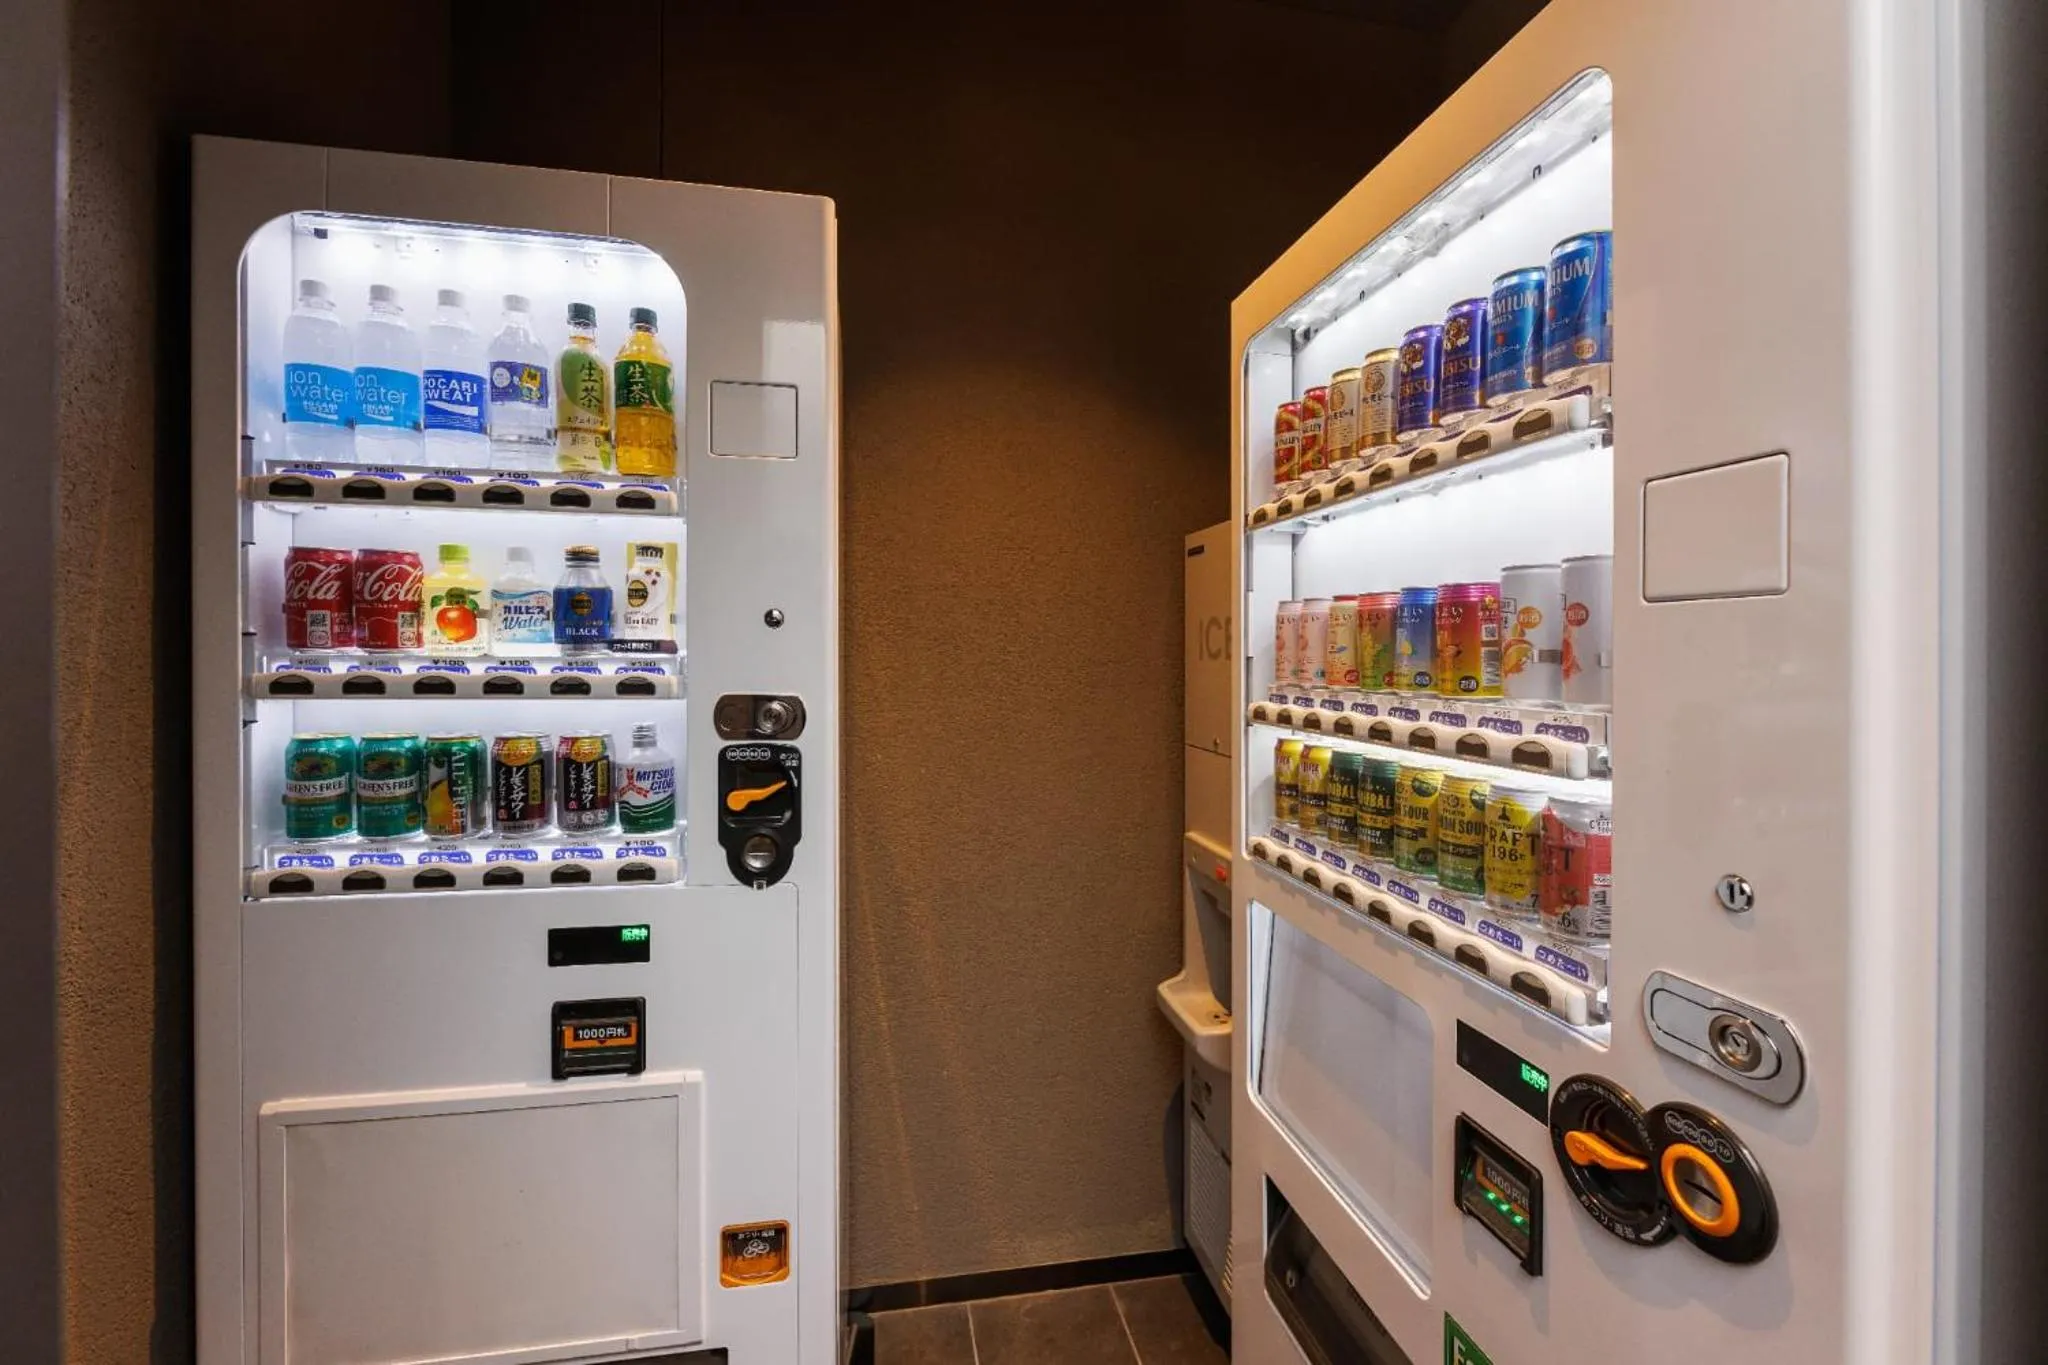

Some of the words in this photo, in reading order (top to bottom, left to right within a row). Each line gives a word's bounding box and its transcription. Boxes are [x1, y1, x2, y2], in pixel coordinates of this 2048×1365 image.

[289, 370, 322, 385] ion
[580, 361, 601, 408] 生茶
[627, 363, 650, 403] 生茶
[290, 384, 349, 404] water
[354, 387, 408, 405] water
[503, 615, 546, 630] Water
[565, 627, 599, 636] BLACK
[320, 779, 344, 792] FREE
[1488, 828, 1540, 857] RAFT
[577, 1027, 628, 1040] 1000円札
